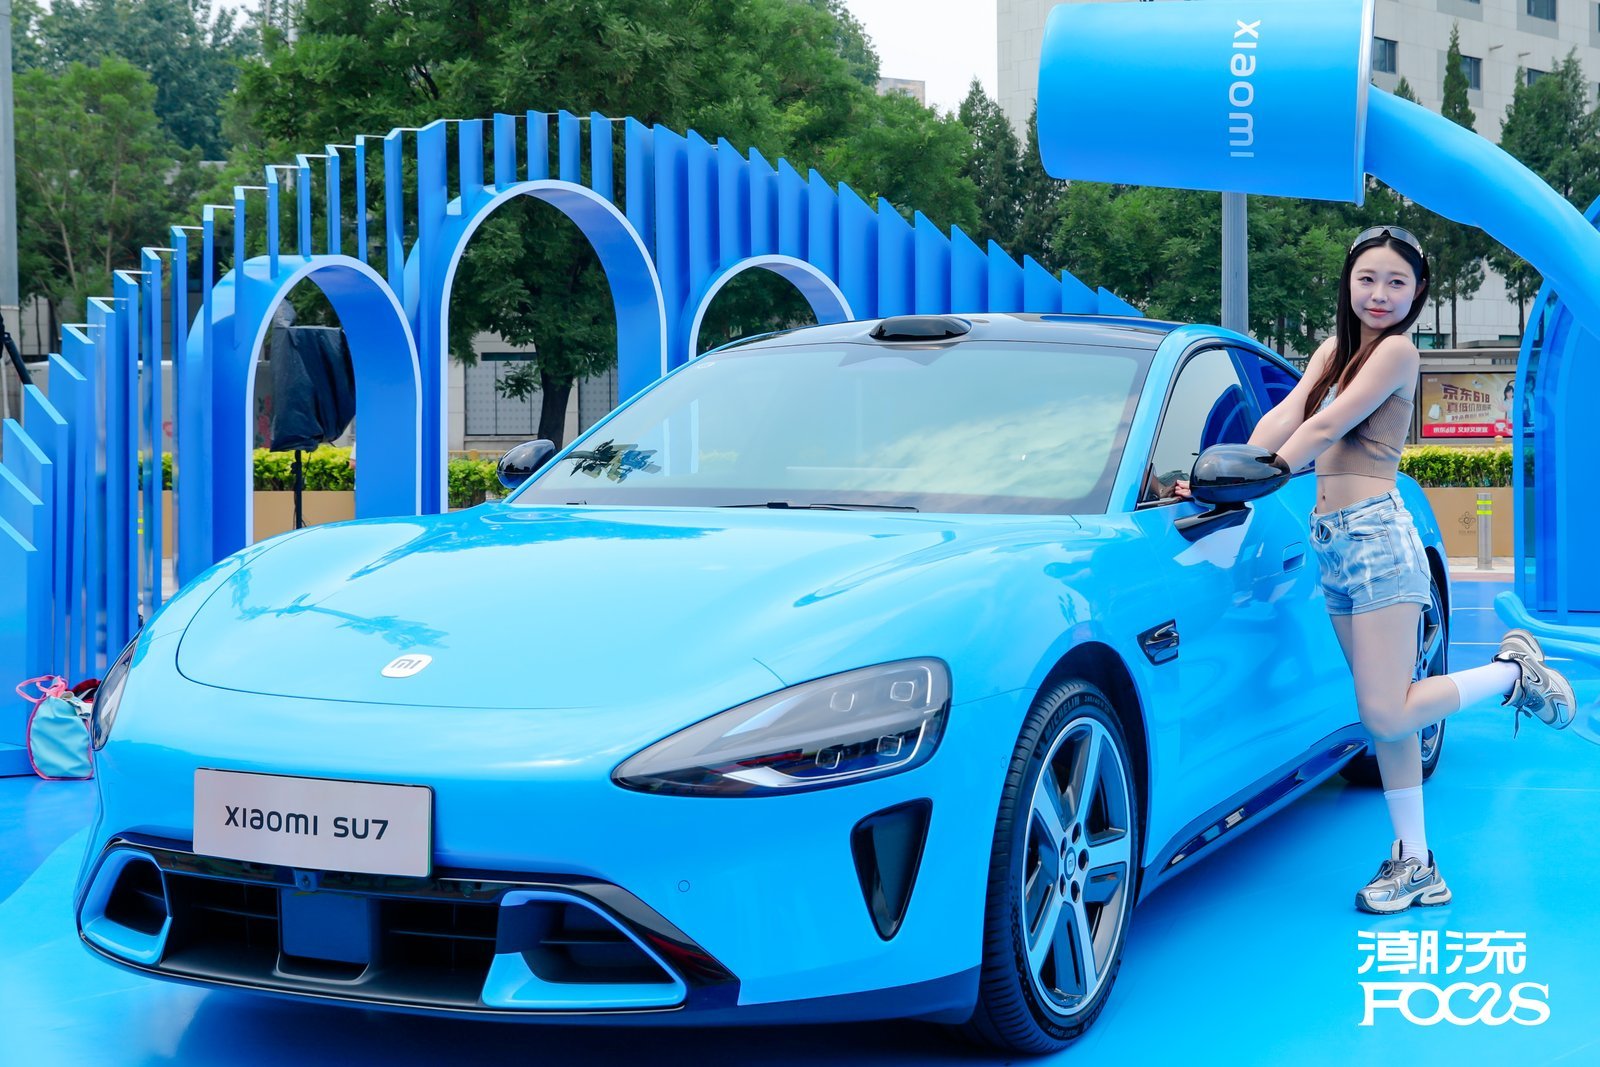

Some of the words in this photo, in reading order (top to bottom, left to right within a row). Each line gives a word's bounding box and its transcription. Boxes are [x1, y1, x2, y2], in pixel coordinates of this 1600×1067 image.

[1228, 19, 1261, 158] xiaomi
[1441, 384, 1490, 403] 京东618
[1043, 695, 1080, 740] MICHELIN
[333, 816, 389, 840] SU7
